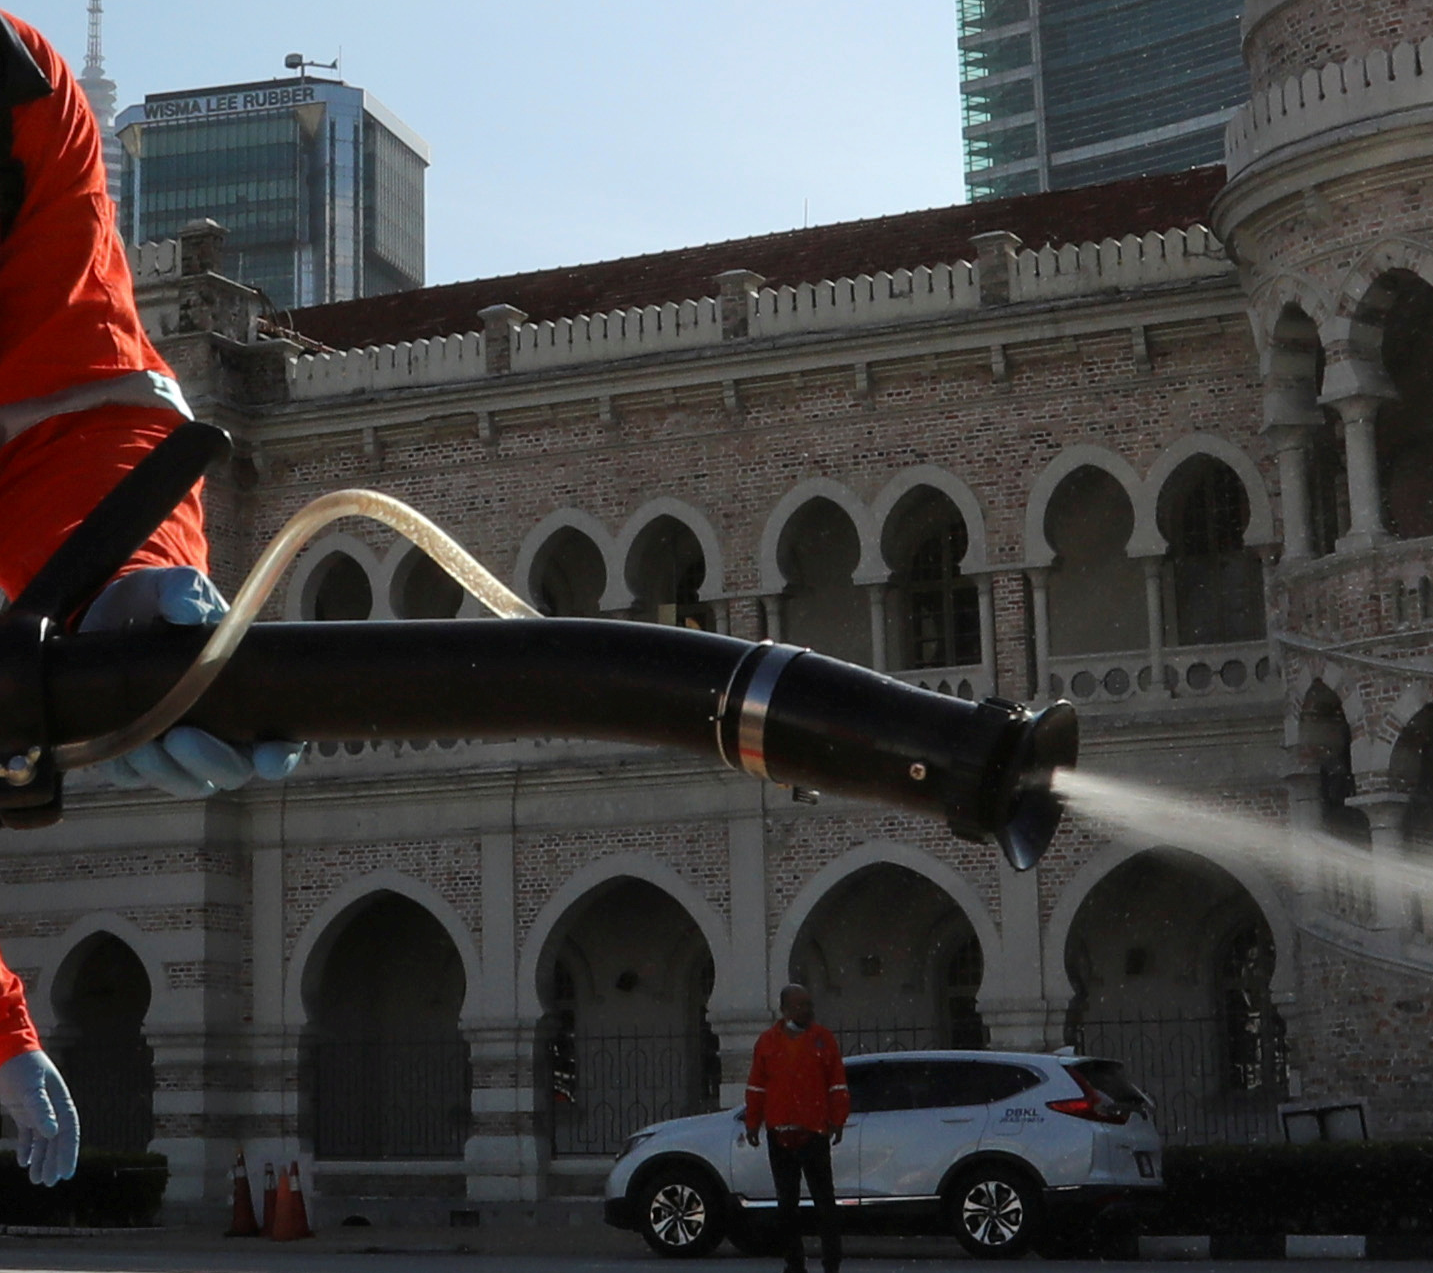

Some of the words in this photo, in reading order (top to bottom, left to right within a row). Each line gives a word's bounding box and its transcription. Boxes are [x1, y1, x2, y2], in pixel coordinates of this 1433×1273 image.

[145, 100, 203, 120] WISMA
[206, 95, 239, 111] LEE
[243, 87, 315, 109] RUBBER
